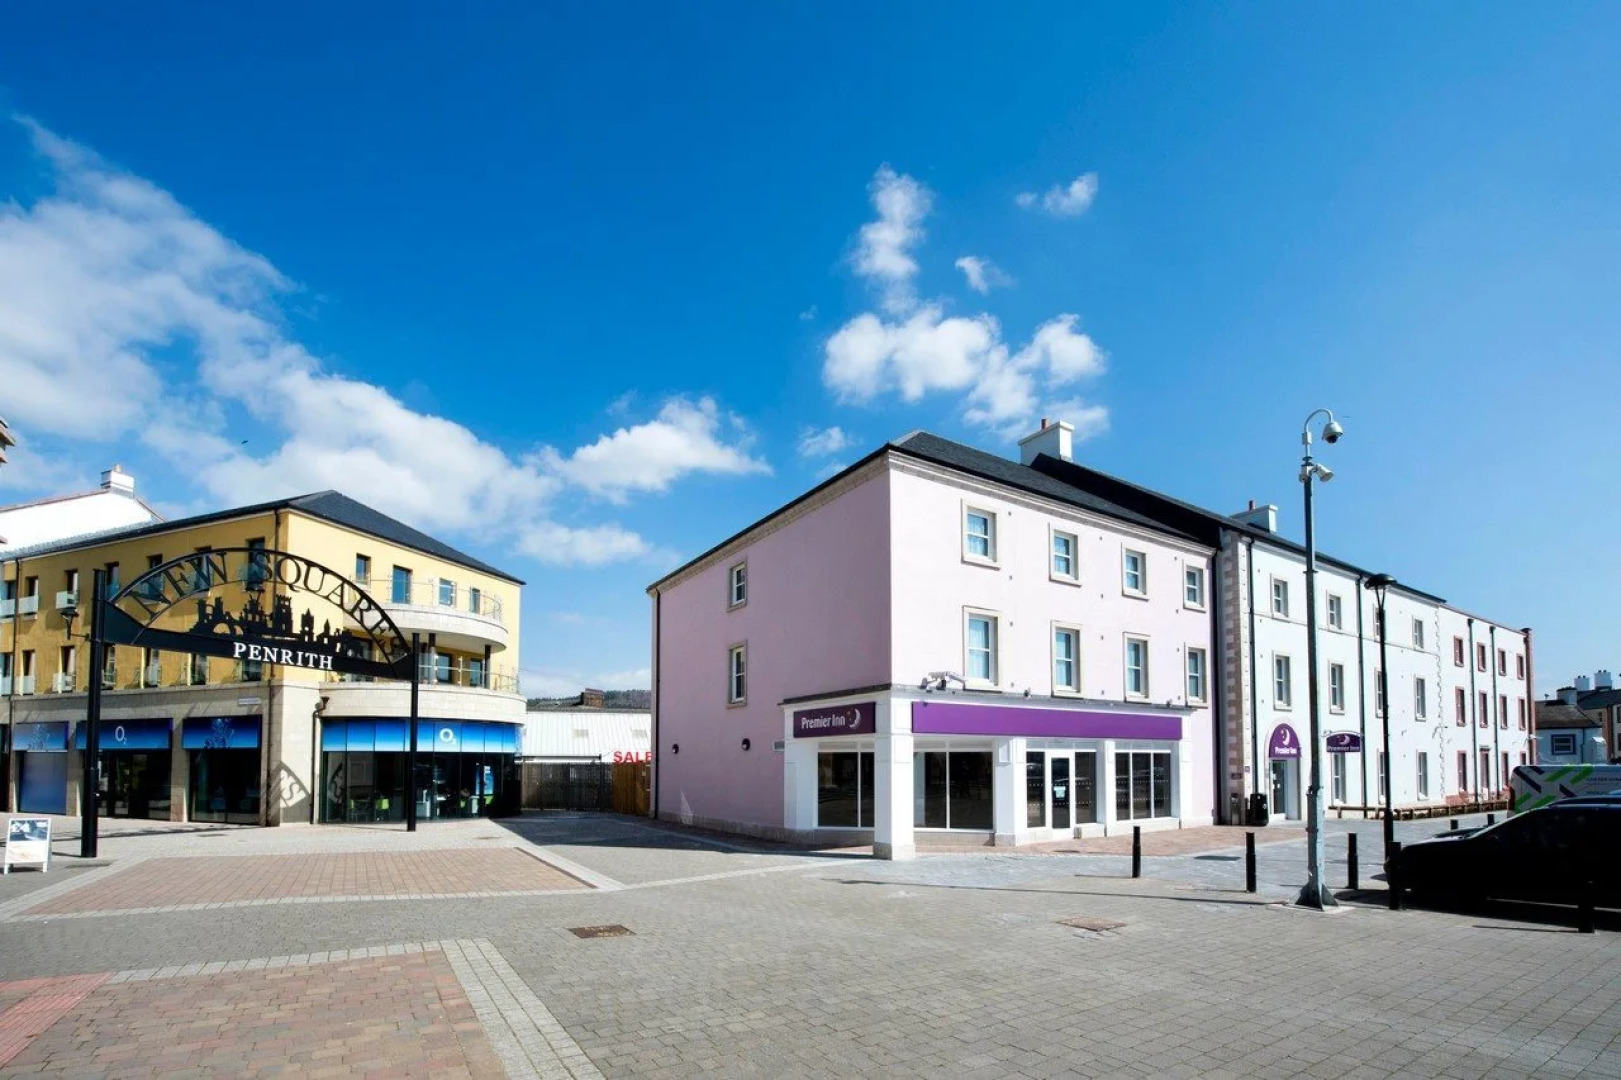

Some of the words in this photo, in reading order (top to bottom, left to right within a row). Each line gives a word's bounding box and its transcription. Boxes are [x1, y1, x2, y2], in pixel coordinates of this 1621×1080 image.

[122, 551, 228, 616] NEW
[233, 642, 333, 670] PENRITH
[801, 715, 831, 729] Premier
[832, 713, 846, 727] Inn
